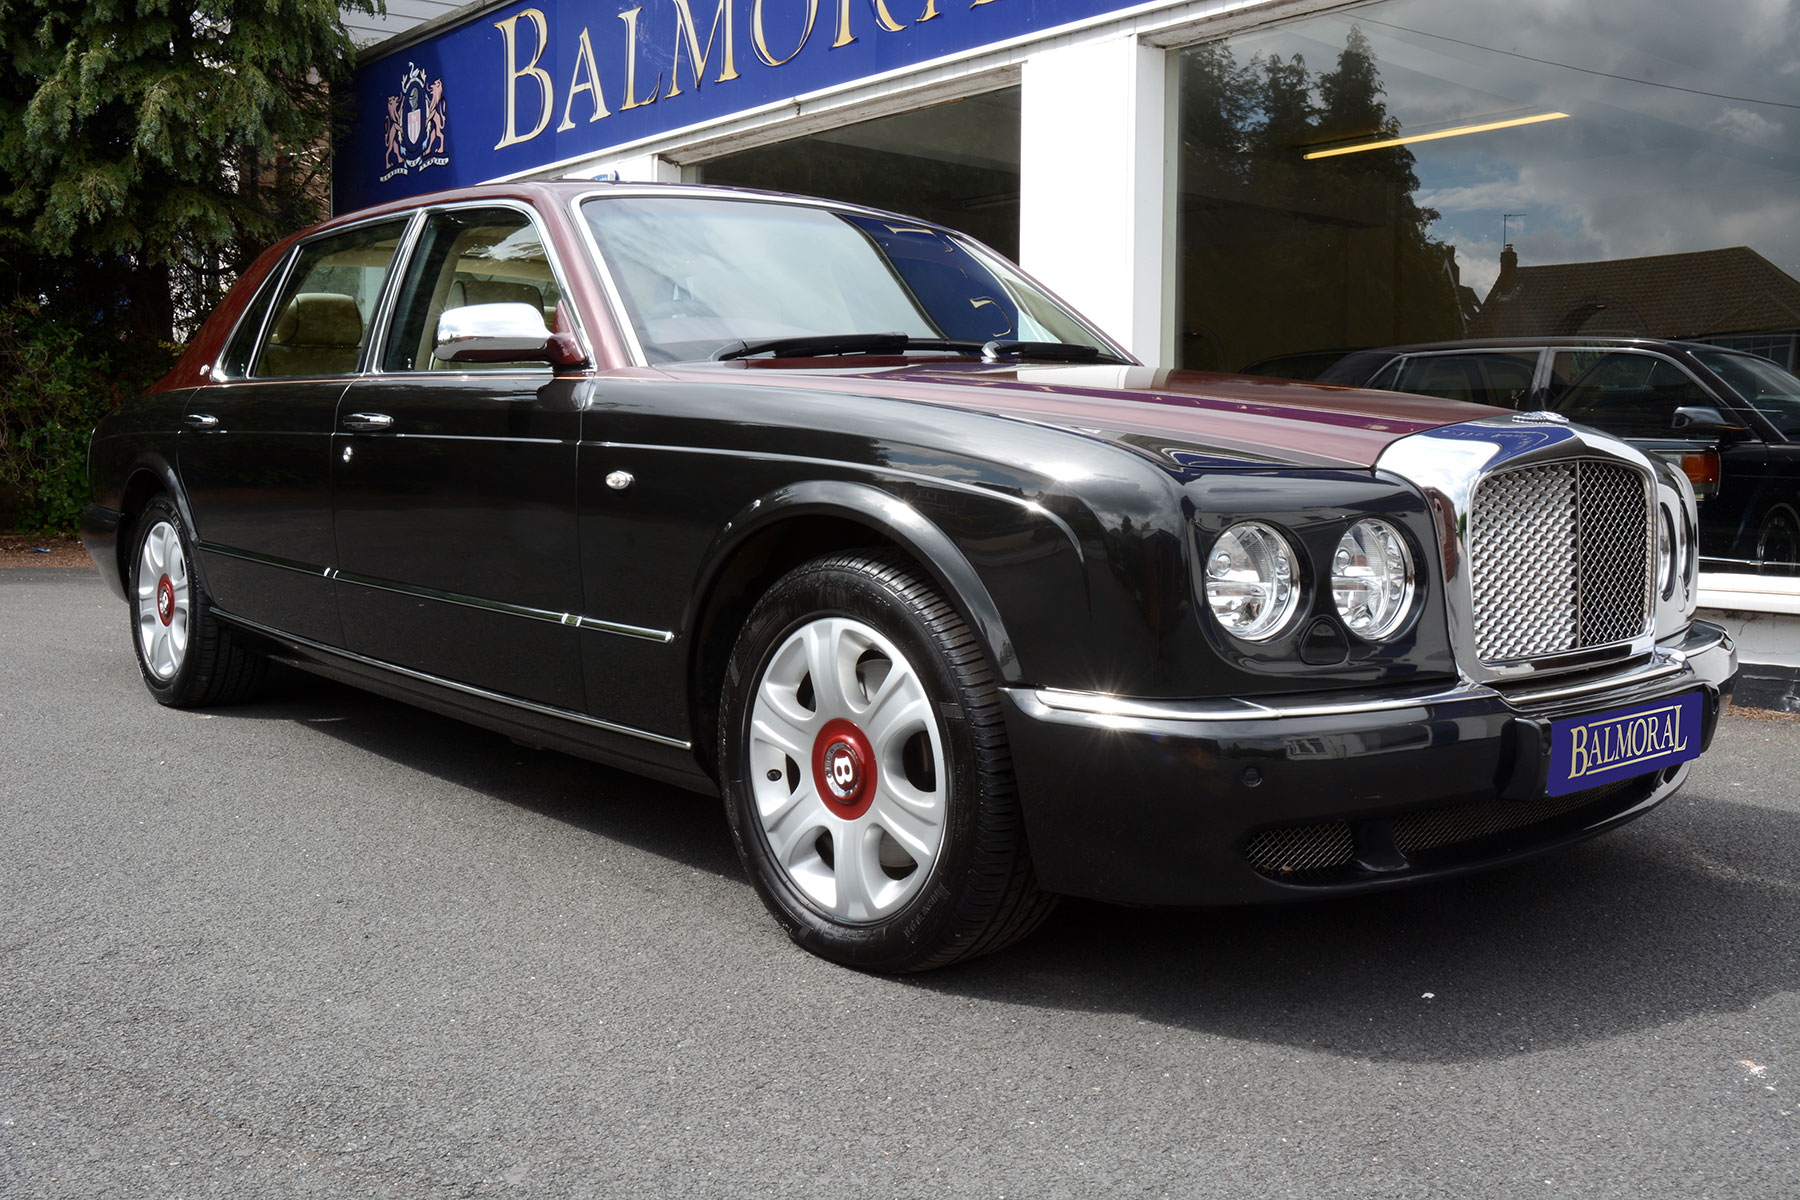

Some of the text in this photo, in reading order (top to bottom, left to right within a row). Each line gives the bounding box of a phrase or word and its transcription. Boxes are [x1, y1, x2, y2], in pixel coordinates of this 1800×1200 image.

[494, 0, 998, 151] BALMO
[833, 756, 853, 785] B
[1567, 704, 1688, 780] BALMORAL
